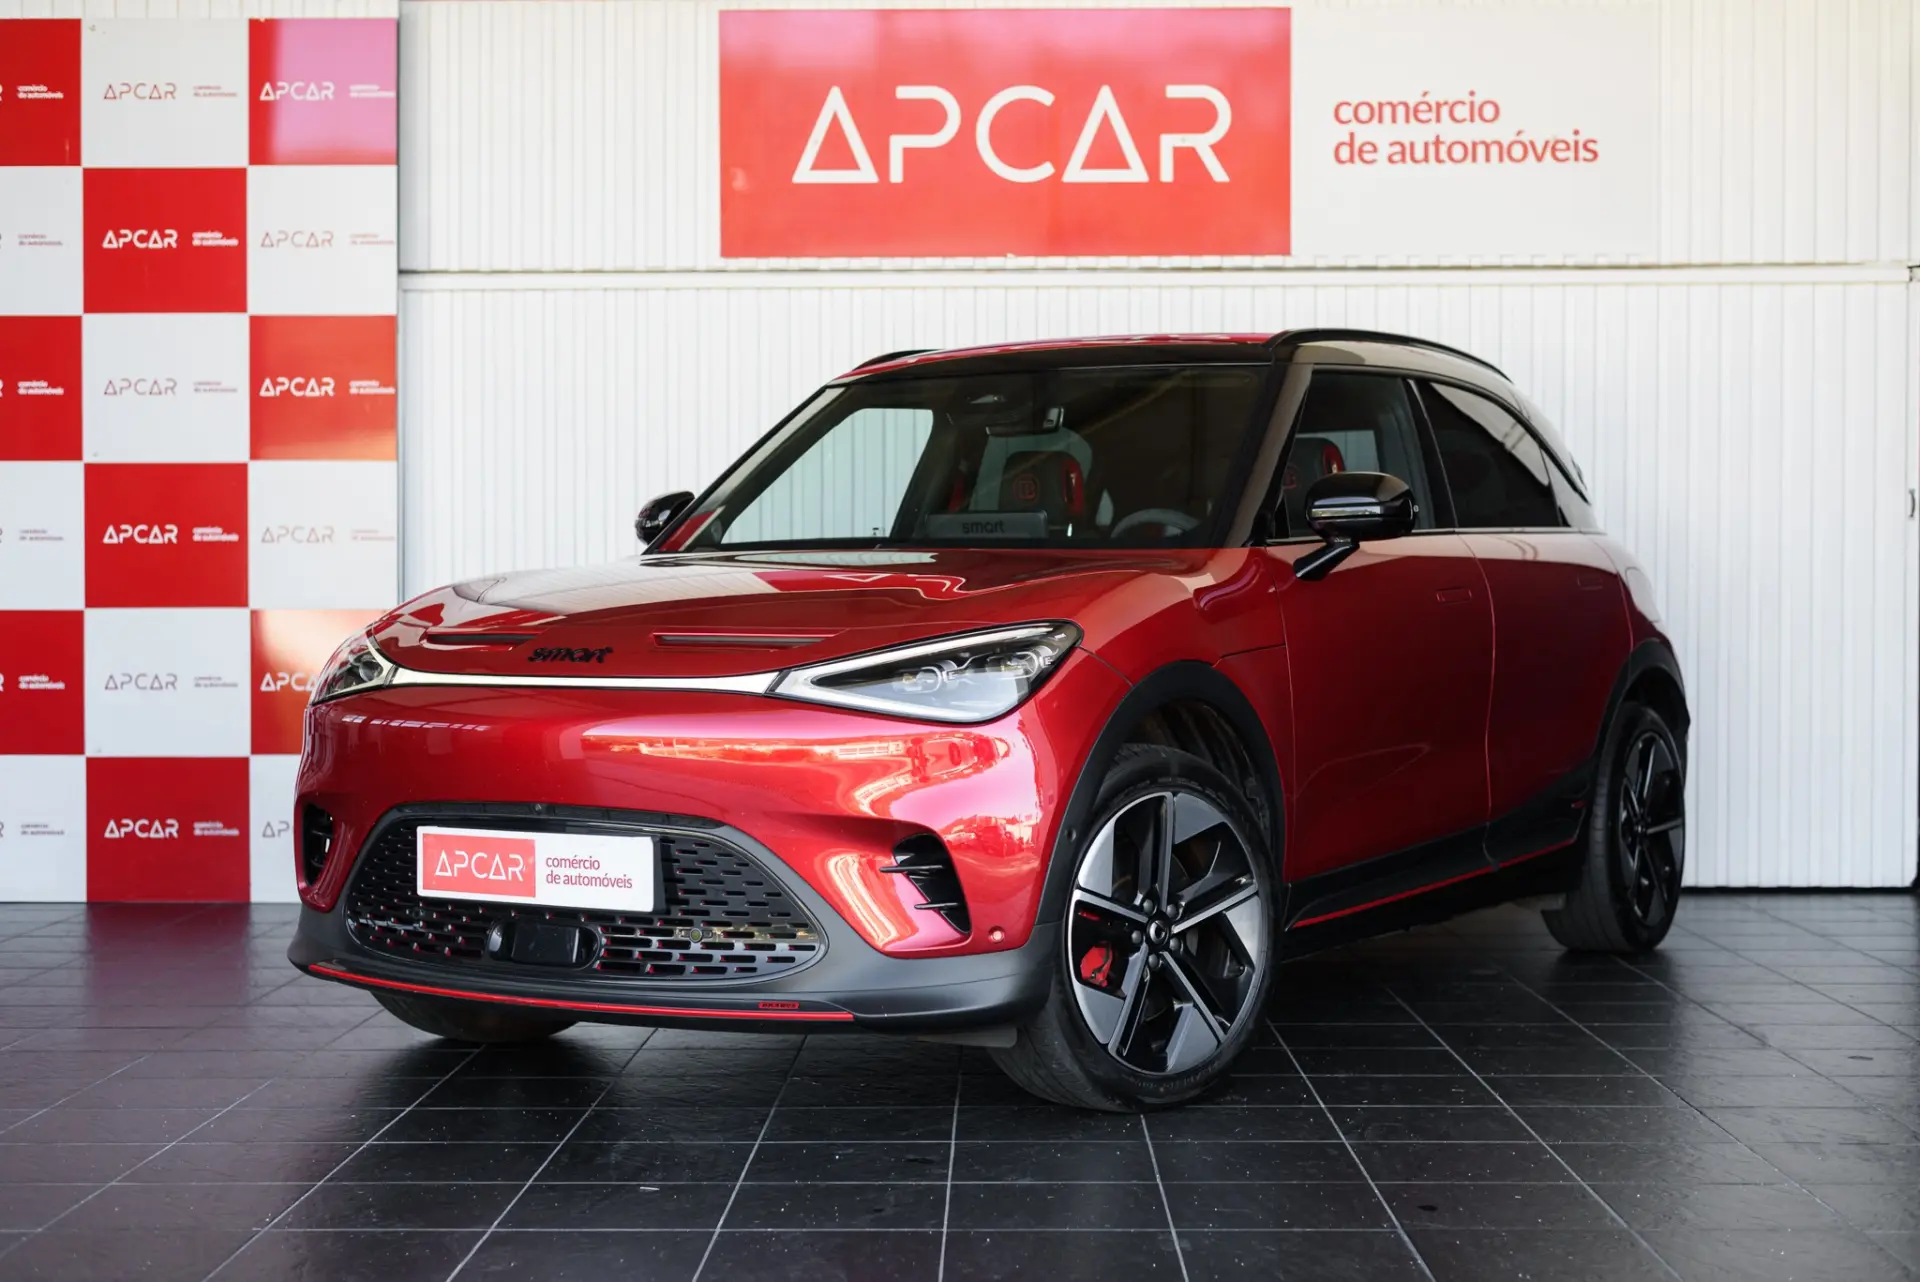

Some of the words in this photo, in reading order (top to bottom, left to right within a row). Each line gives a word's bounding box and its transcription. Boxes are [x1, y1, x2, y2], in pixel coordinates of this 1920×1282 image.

[103, 82, 177, 101] APCAR
[260, 82, 336, 101] APCAR
[1333, 90, 1500, 125] comércio
[791, 84, 1232, 184] APCAR
[1333, 131, 1379, 165] de
[1387, 129, 1599, 165] automóveis
[102, 229, 178, 249] APCAR
[260, 230, 334, 249] APCAR
[103, 377, 178, 396] APCAR
[260, 377, 336, 397] APCAR
[103, 524, 178, 544] APCAR
[260, 525, 335, 544] APCAR
[962, 520, 1005, 534] smart
[527, 647, 614, 664] smart
[104, 672, 178, 691] APCAR
[260, 671, 319, 691] APCA
[104, 818, 179, 839] APCAR
[434, 849, 524, 882] APCAR
[545, 854, 601, 870] comércio
[545, 870, 561, 884] de
[562, 873, 633, 889] automóveis
